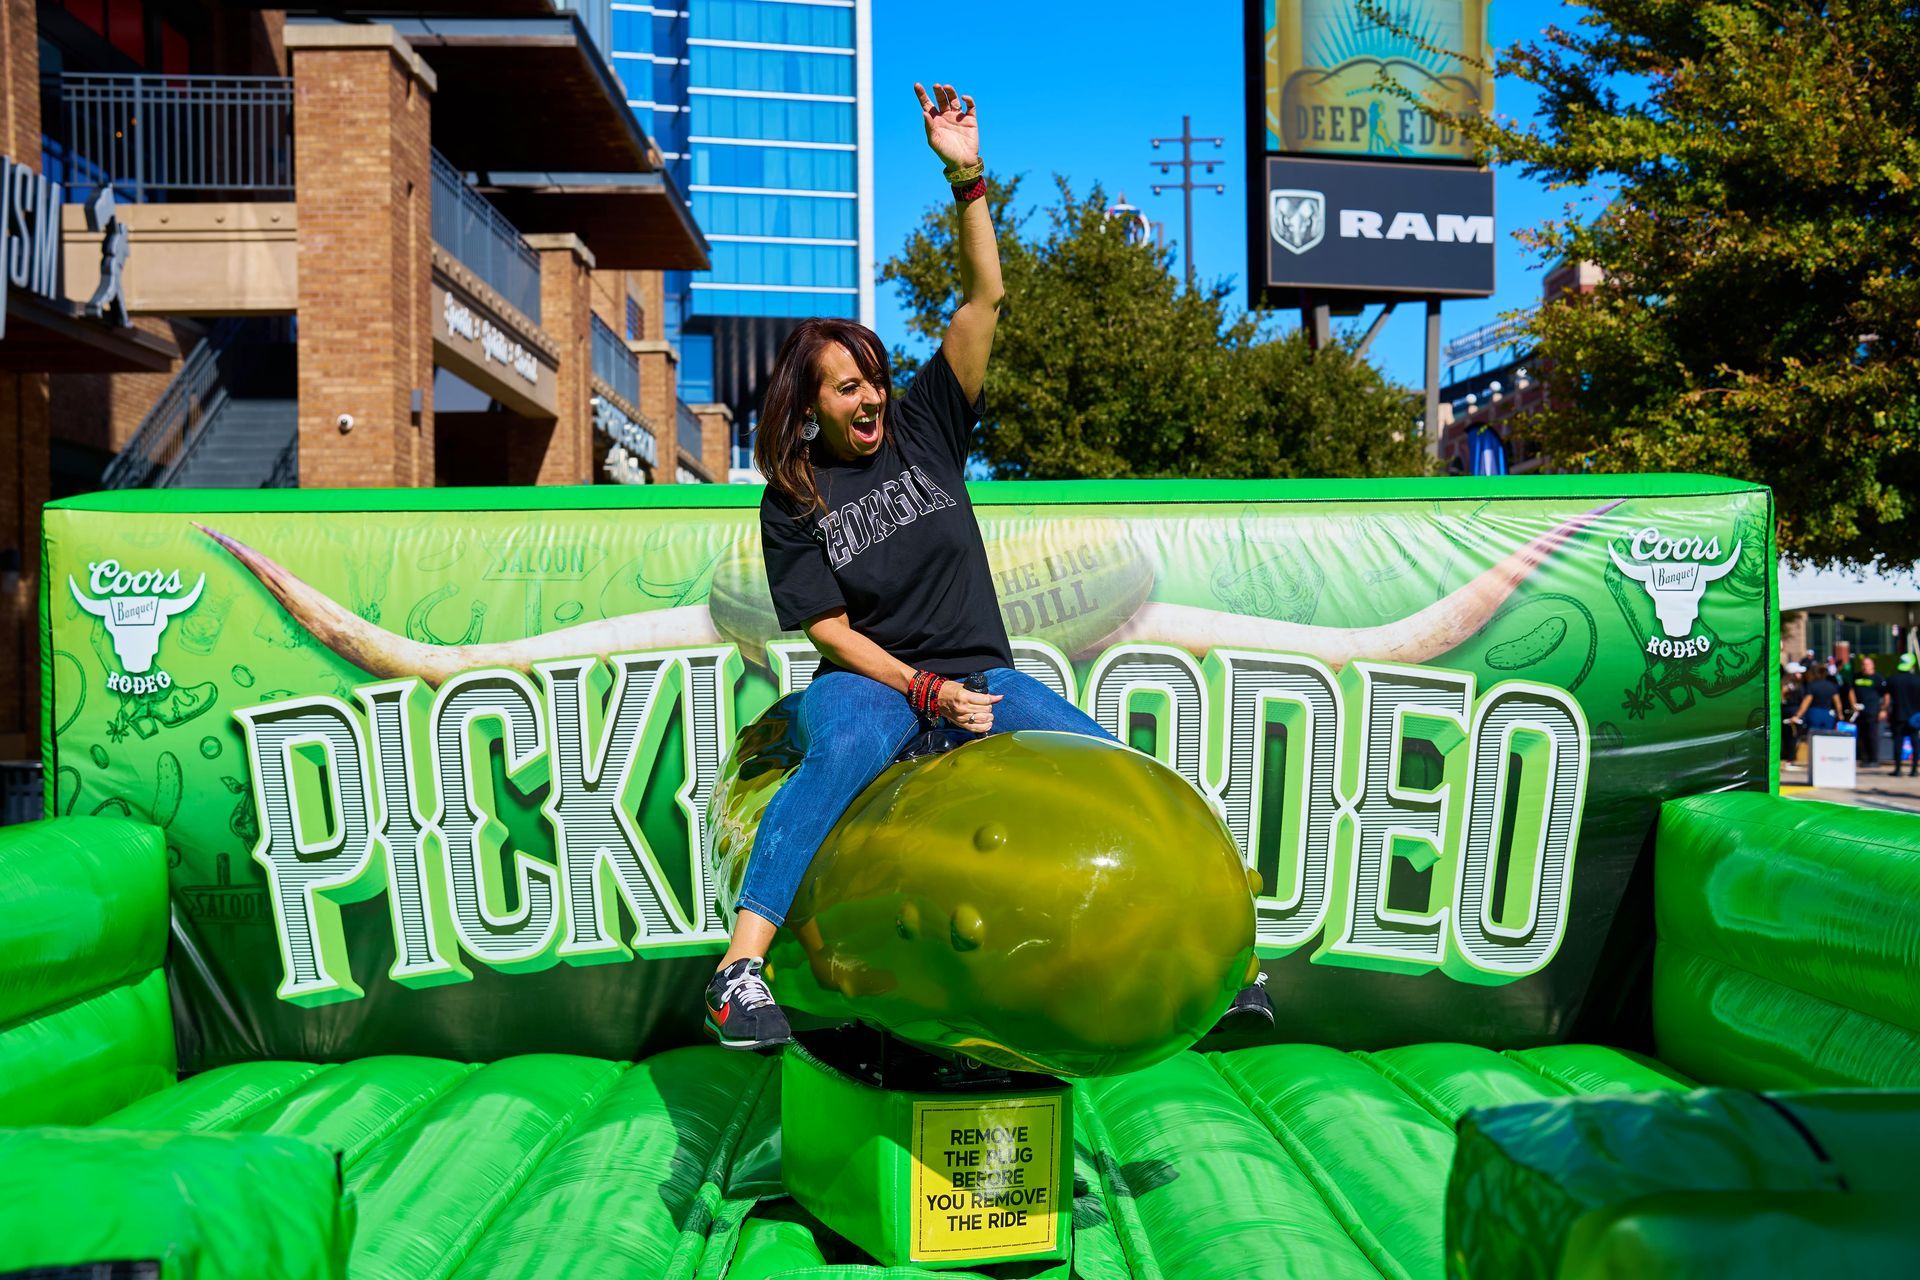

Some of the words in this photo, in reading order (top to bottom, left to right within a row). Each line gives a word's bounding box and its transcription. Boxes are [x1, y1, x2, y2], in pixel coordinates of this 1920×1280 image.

[1295, 104, 1368, 142] DEEP
[1339, 209, 1494, 244] RAM
[813, 465, 957, 572] EORGIA
[1629, 527, 1722, 560] Coors
[497, 543, 586, 573] SALOON
[994, 562, 1040, 598] HE
[1044, 543, 1099, 583] BIG
[88, 559, 183, 595] Coors
[1658, 566, 1694, 587] Banquet
[117, 600, 154, 621] Banquet
[1001, 579, 1100, 637] DILL
[1646, 635, 1710, 659] RODEO
[106, 670, 172, 695] RODEO
[232, 638, 822, 1003] PICKL
[1008, 638, 1591, 978] ODEO
[951, 1126, 1029, 1146] REMOVE
[944, 1150, 980, 1167] THE
[986, 1147, 1033, 1166] PLUG
[952, 1168, 1025, 1188] BEFORE
[926, 1193, 965, 1211] YOU
[971, 1187, 1047, 1209] REMOVE
[946, 1214, 982, 1232] THE
[988, 1209, 1028, 1229] RIDE
